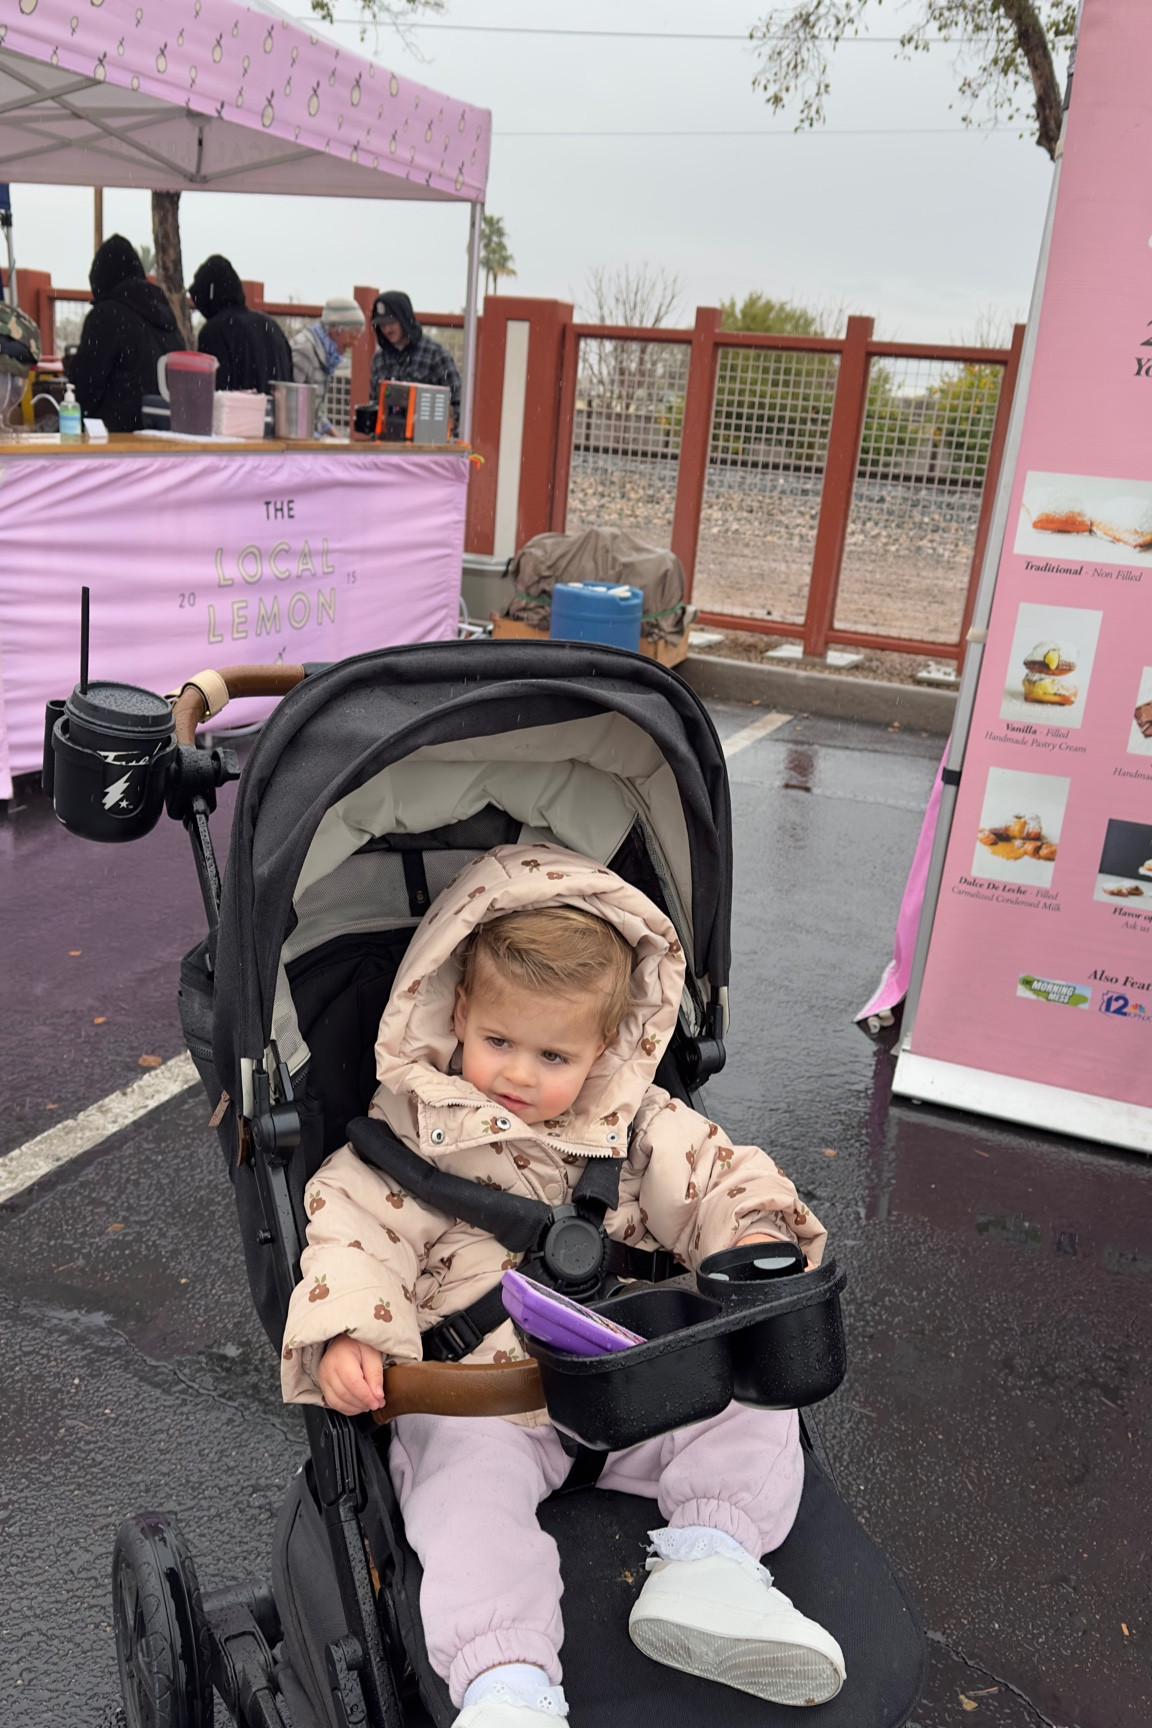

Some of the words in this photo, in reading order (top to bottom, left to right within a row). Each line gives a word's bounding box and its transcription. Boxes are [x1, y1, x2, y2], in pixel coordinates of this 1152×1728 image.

[264, 499, 295, 520] THE
[214, 537, 335, 589] LOCAL
[1024, 560, 1084, 576] Traditional
[1092, 567, 1113, 579] Non
[1115, 569, 1143, 581] Filled
[346, 570, 358, 585] 15
[178, 591, 196, 609] 20
[207, 586, 336, 645] LEMON
[1005, 722, 1038, 735] Vanilla
[1045, 728, 1070, 739] Filled
[984, 731, 1029, 745] Handmade
[1030, 738, 1058, 751] Pastry
[1058, 742, 1087, 753] Cream
[958, 876, 985, 888] Dulce
[986, 882, 1000, 892] De
[1002, 885, 1028, 895] Leche
[1035, 889, 1059, 901] Filled
[1041, 902, 1062, 912] Milk
[1113, 906, 1142, 919] Flavor
[1121, 920, 1137, 930] Ask
[1031, 980, 1075, 996] MORNING
[1087, 969, 1119, 985] Also
[1122, 976, 1152, 991] Feat
[1104, 994, 1130, 1017] 12
